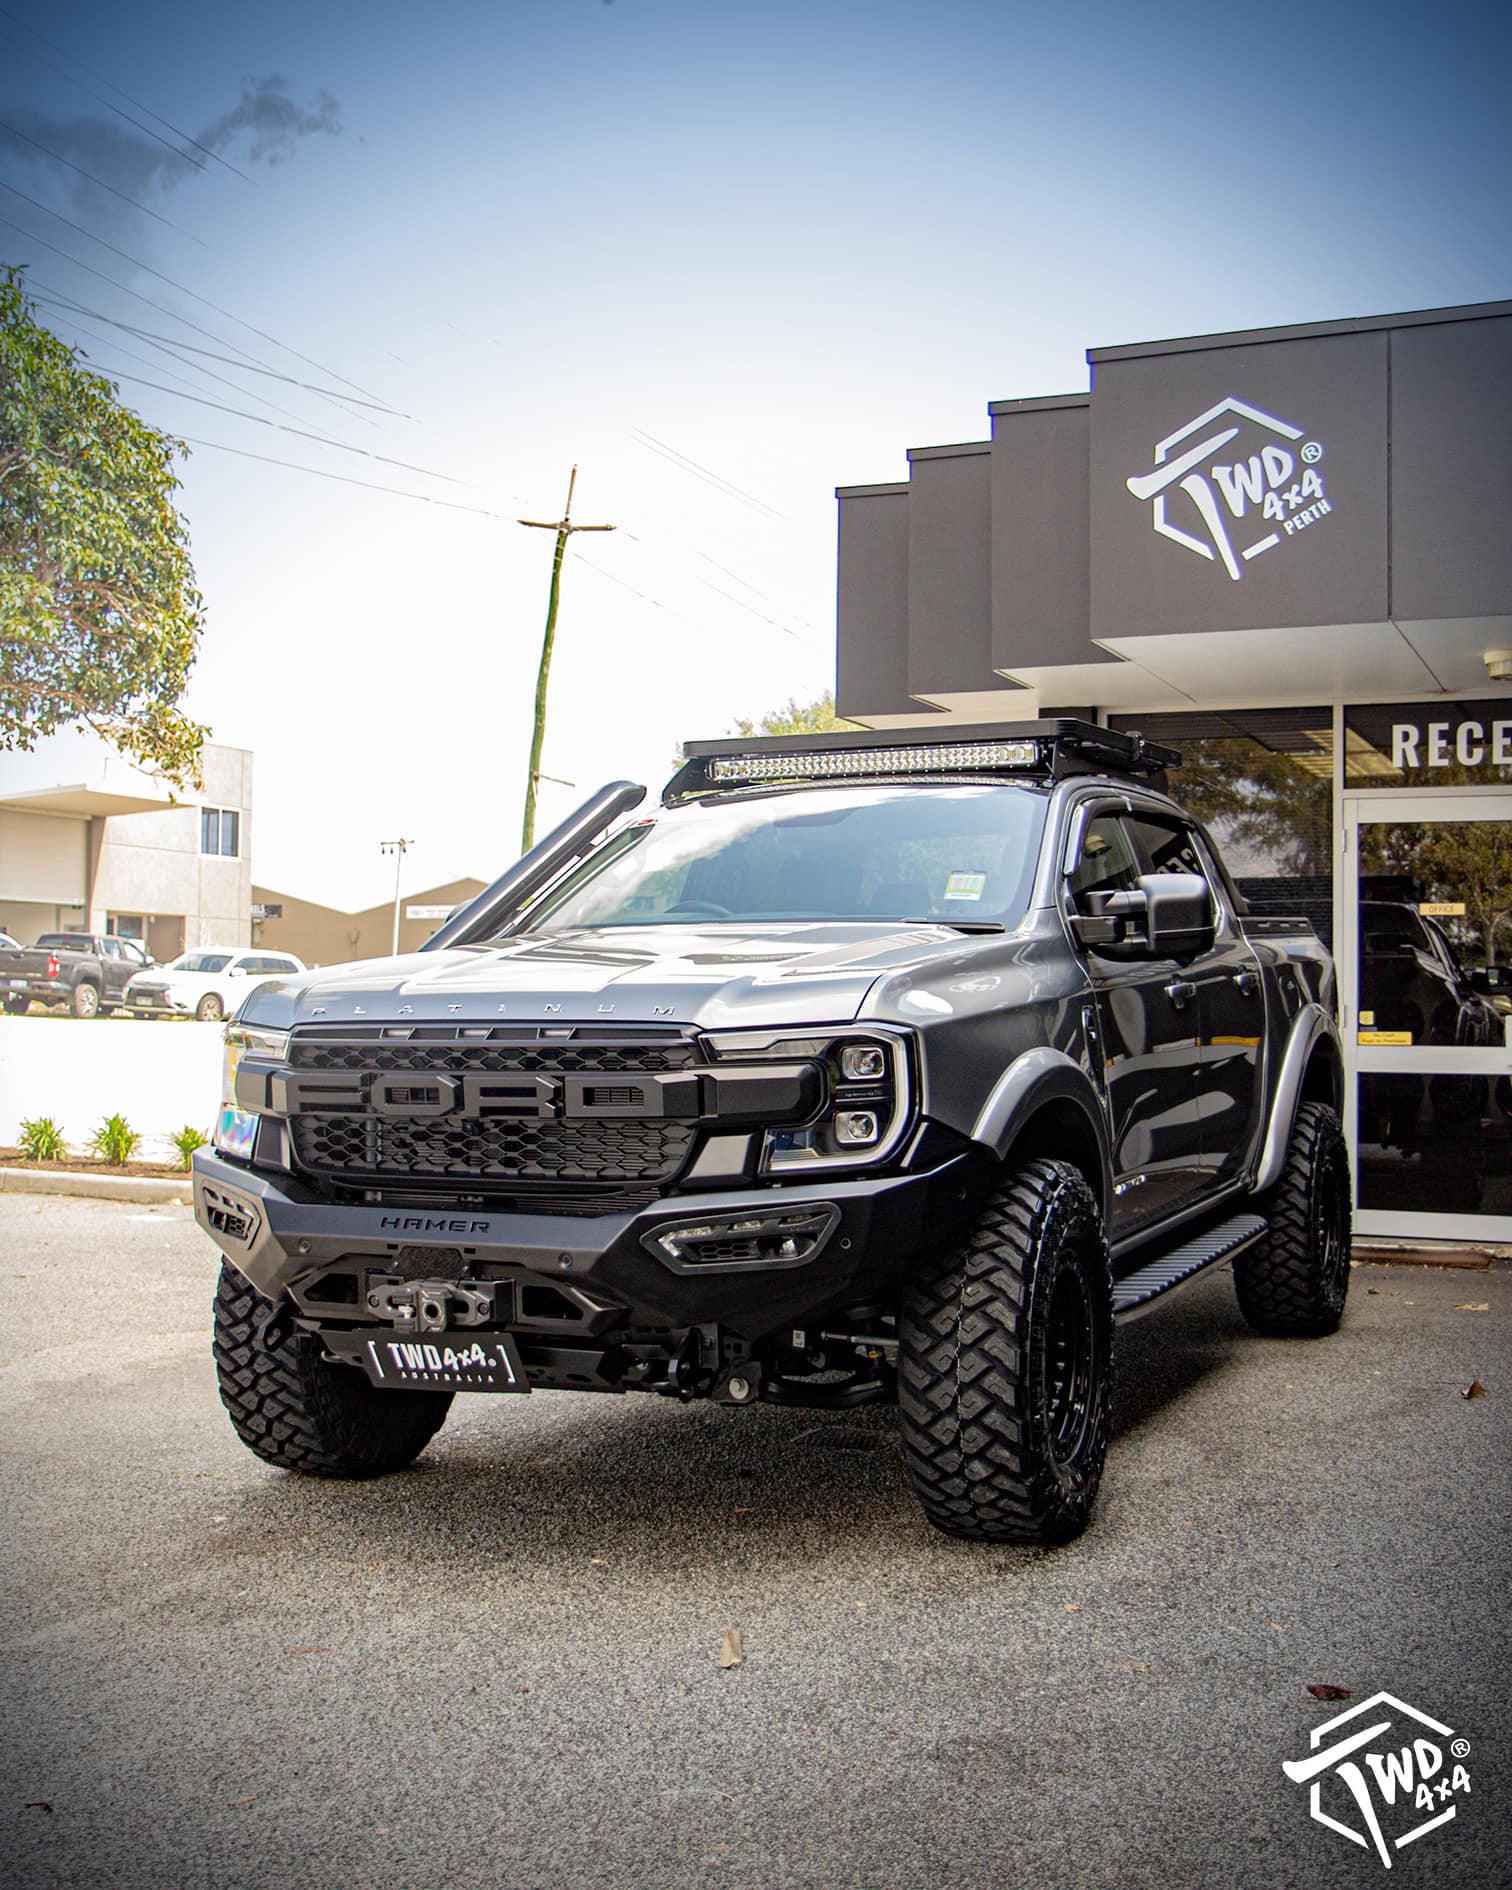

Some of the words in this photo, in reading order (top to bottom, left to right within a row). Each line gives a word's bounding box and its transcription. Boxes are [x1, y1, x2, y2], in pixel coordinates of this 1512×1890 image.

[1126, 428, 1294, 581] TWD
[1262, 469, 1323, 520] 4x4
[1283, 499, 1332, 535] PERTH
[1392, 720, 1512, 768] RECE
[312, 1002, 676, 1016] PLATINUM
[271, 1070, 700, 1119] FORD
[380, 1216, 490, 1233] HAMER
[401, 1371, 495, 1383] AUSTRALIA
